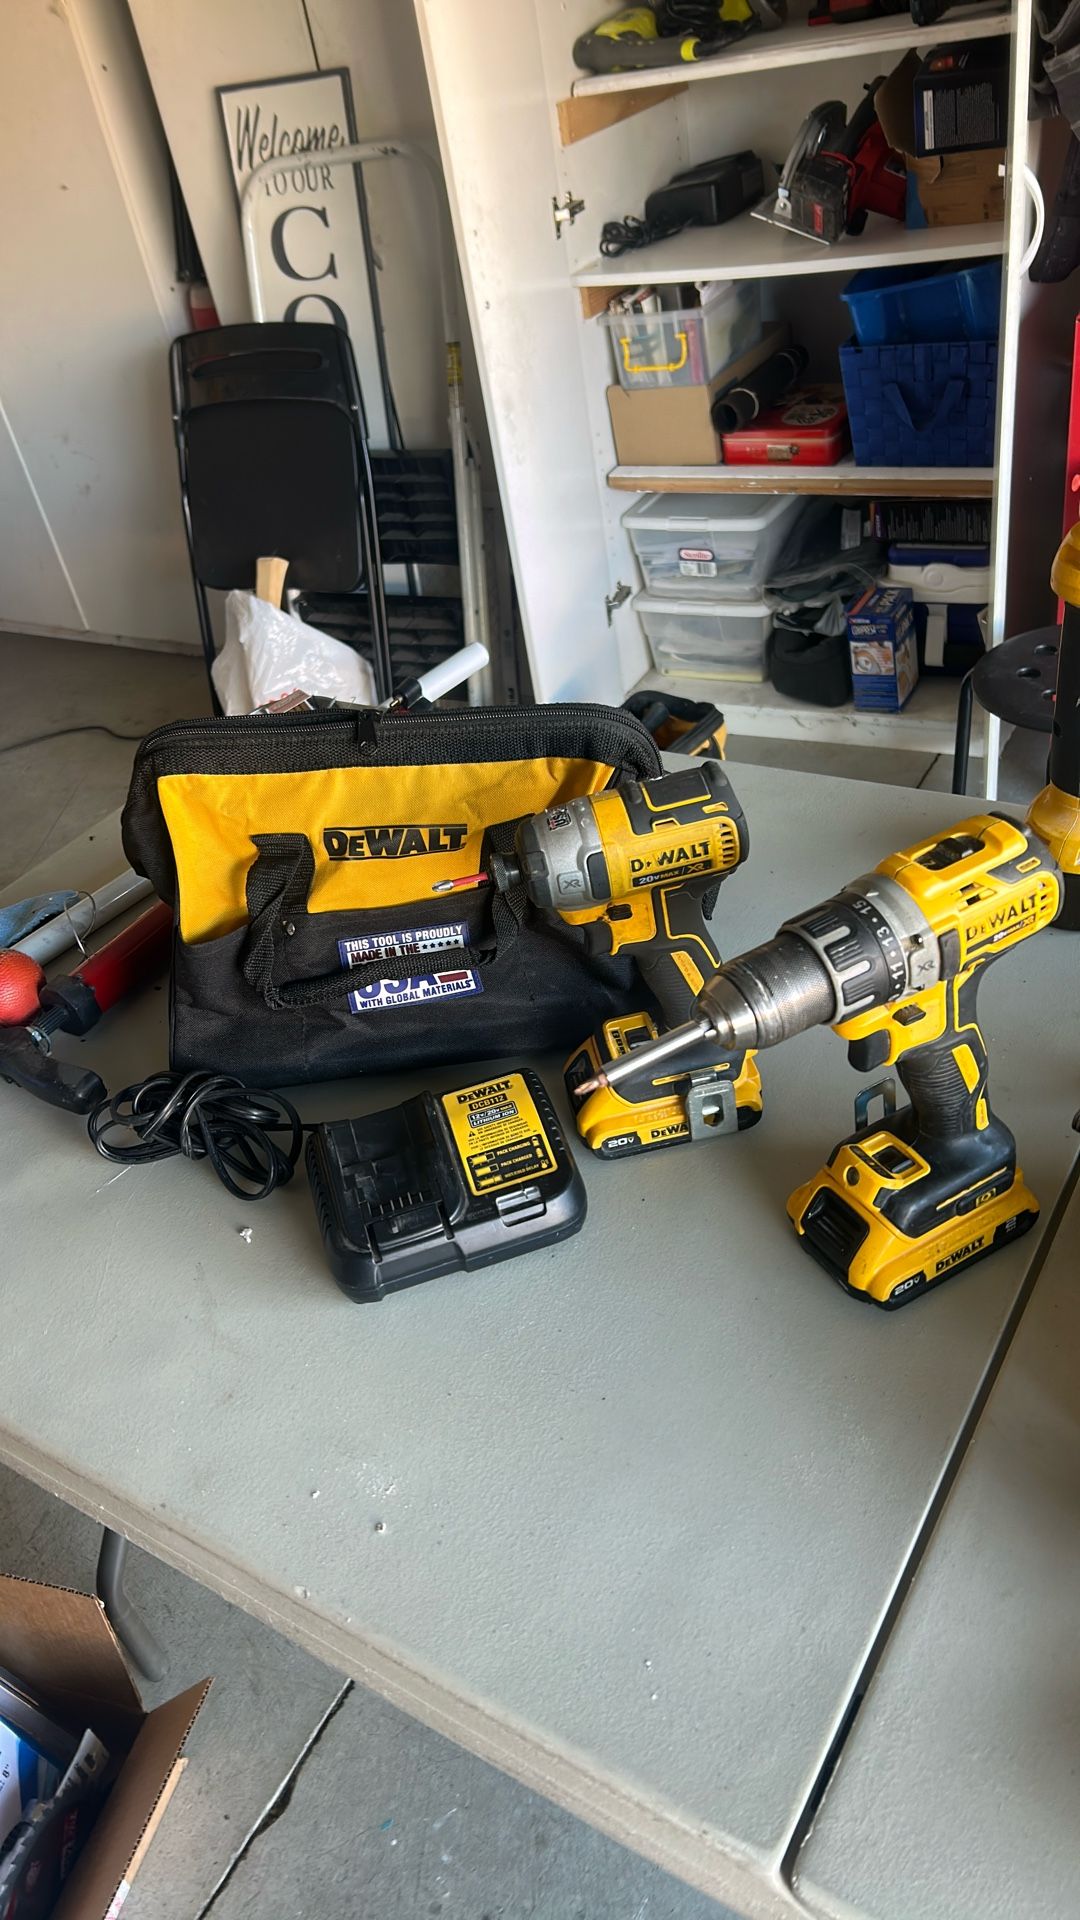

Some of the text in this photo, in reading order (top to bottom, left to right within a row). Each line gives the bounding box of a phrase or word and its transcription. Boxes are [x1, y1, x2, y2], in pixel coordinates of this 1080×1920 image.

[237, 104, 345, 171] Welcome
[291, 162, 335, 194] OUR
[323, 828, 467, 857] DEWALT
[630, 840, 710, 872] DWALT
[852, 901, 872, 915] 15
[344, 925, 462, 952] THIS TOOL IS PROUDLY
[876, 926, 894, 946] 13
[350, 943, 420, 963] MADE IN THE
[890, 962, 904, 980] 11
[360, 980, 471, 1009] WITH GLOBAL MATERIALS
[457, 1081, 512, 1103] DEWALT
[472, 1095, 505, 1109] DCB112
[473, 1114, 501, 1126] LITHIUM
[502, 1109, 515, 1117] ION
[650, 1123, 690, 1139] DEWA
[936, 1236, 985, 1274] DEWALT
